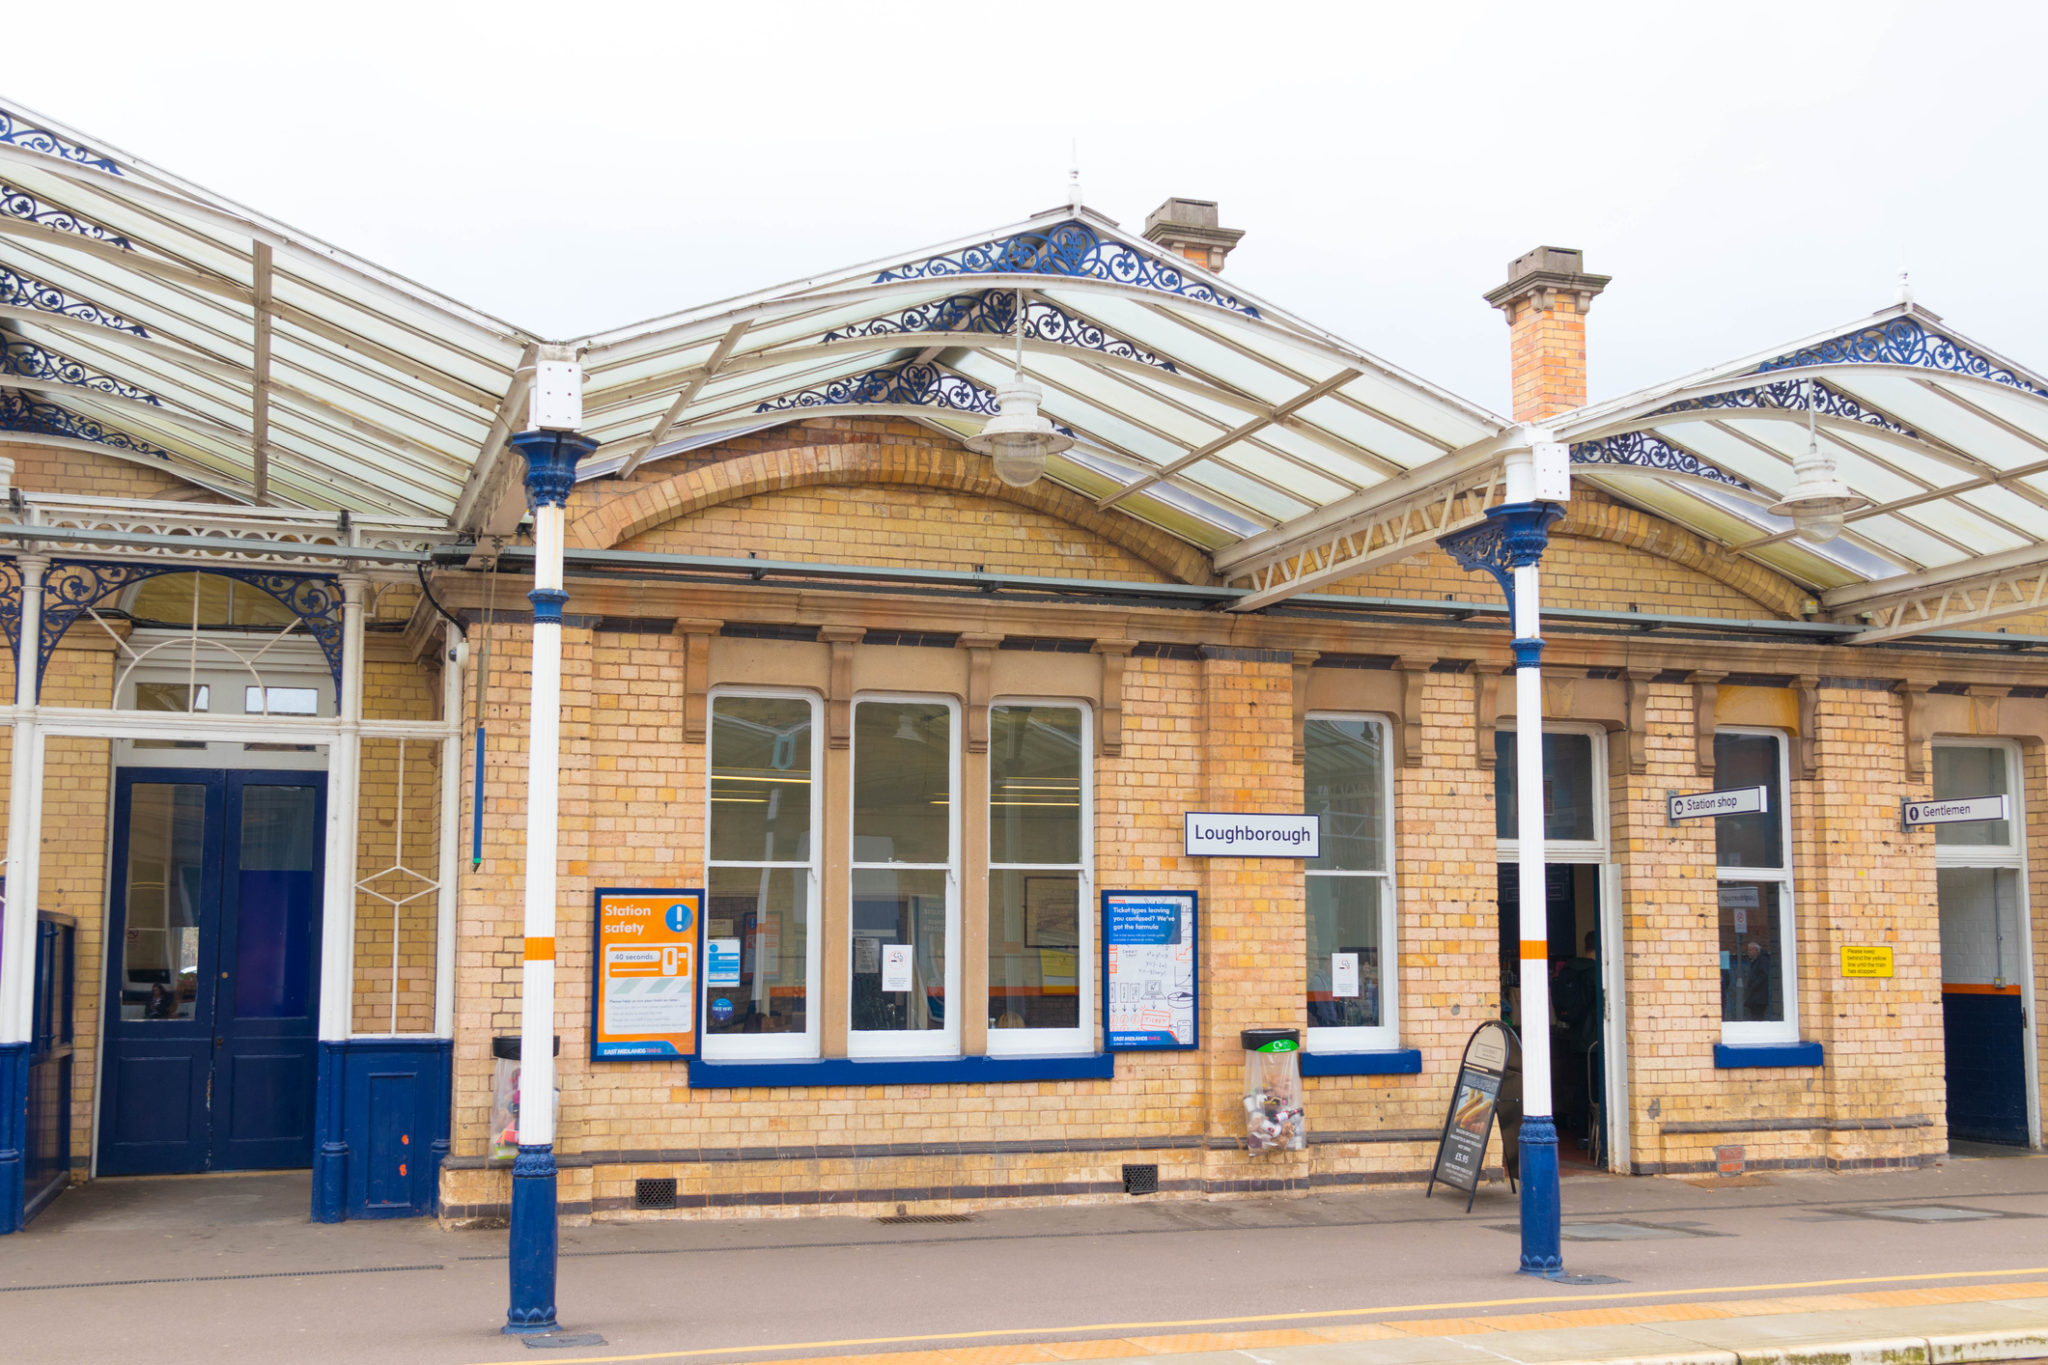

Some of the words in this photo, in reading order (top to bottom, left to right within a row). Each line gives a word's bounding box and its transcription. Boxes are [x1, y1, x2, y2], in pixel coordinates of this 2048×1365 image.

[1686, 798, 1715, 811] Station
[1717, 796, 1737, 808] shop
[1922, 805, 1971, 817] Gentlemen
[1195, 824, 1311, 845] Loughborough
[604, 904, 652, 916] Station
[604, 921, 645, 936] safety
[625, 952, 653, 960] seconds
